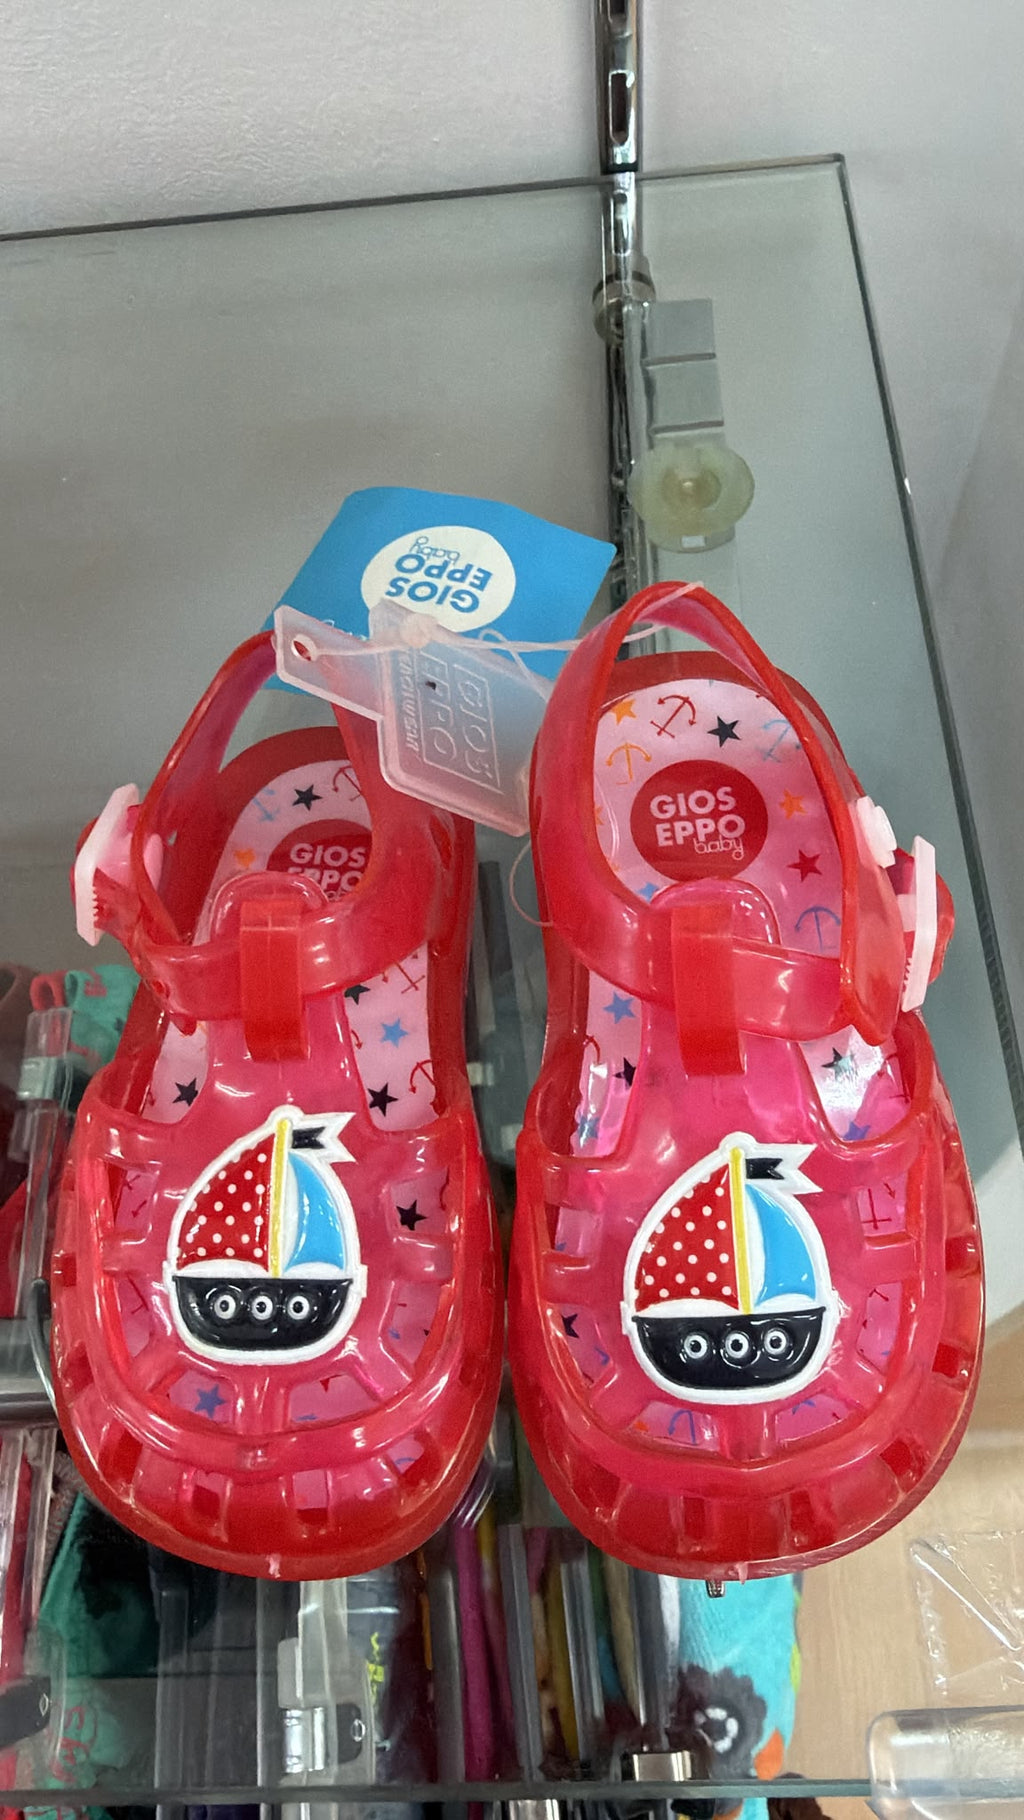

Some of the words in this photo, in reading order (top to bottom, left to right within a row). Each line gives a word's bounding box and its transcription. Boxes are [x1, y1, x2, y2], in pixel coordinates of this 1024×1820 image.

[409, 536, 460, 566] baby
[395, 554, 493, 592] EPPO
[385, 577, 480, 613] GIOS
[650, 786, 737, 819] GIOS
[656, 814, 746, 847] EPPO
[289, 843, 367, 868] GIOS
[693, 835, 744, 861] baby
[287, 867, 363, 892] PPO
